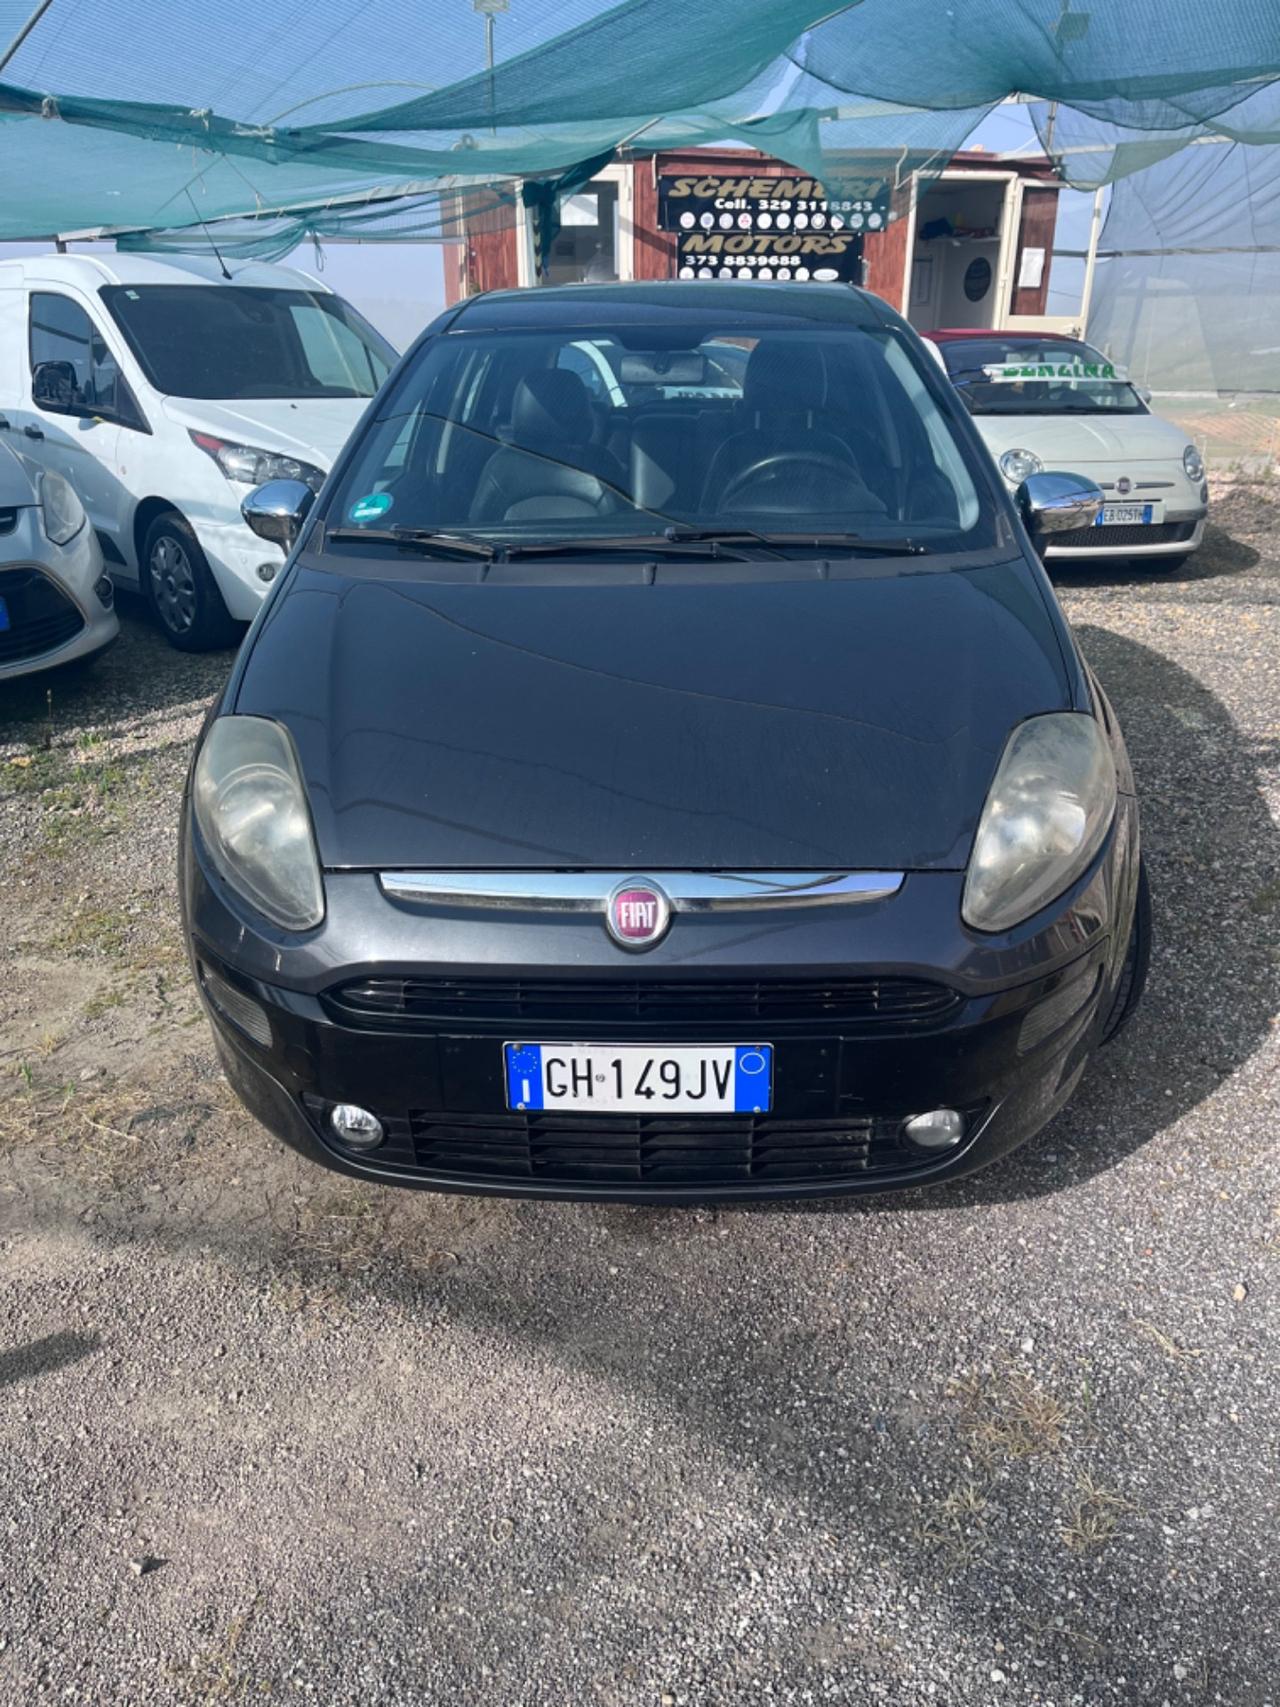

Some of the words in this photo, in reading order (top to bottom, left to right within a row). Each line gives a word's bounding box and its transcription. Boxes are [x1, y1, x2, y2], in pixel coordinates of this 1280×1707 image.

[758, 199, 791, 211] 329
[682, 234, 854, 255] MOTORS
[685, 255, 718, 266] 373
[620, 901, 656, 928] FIAT
